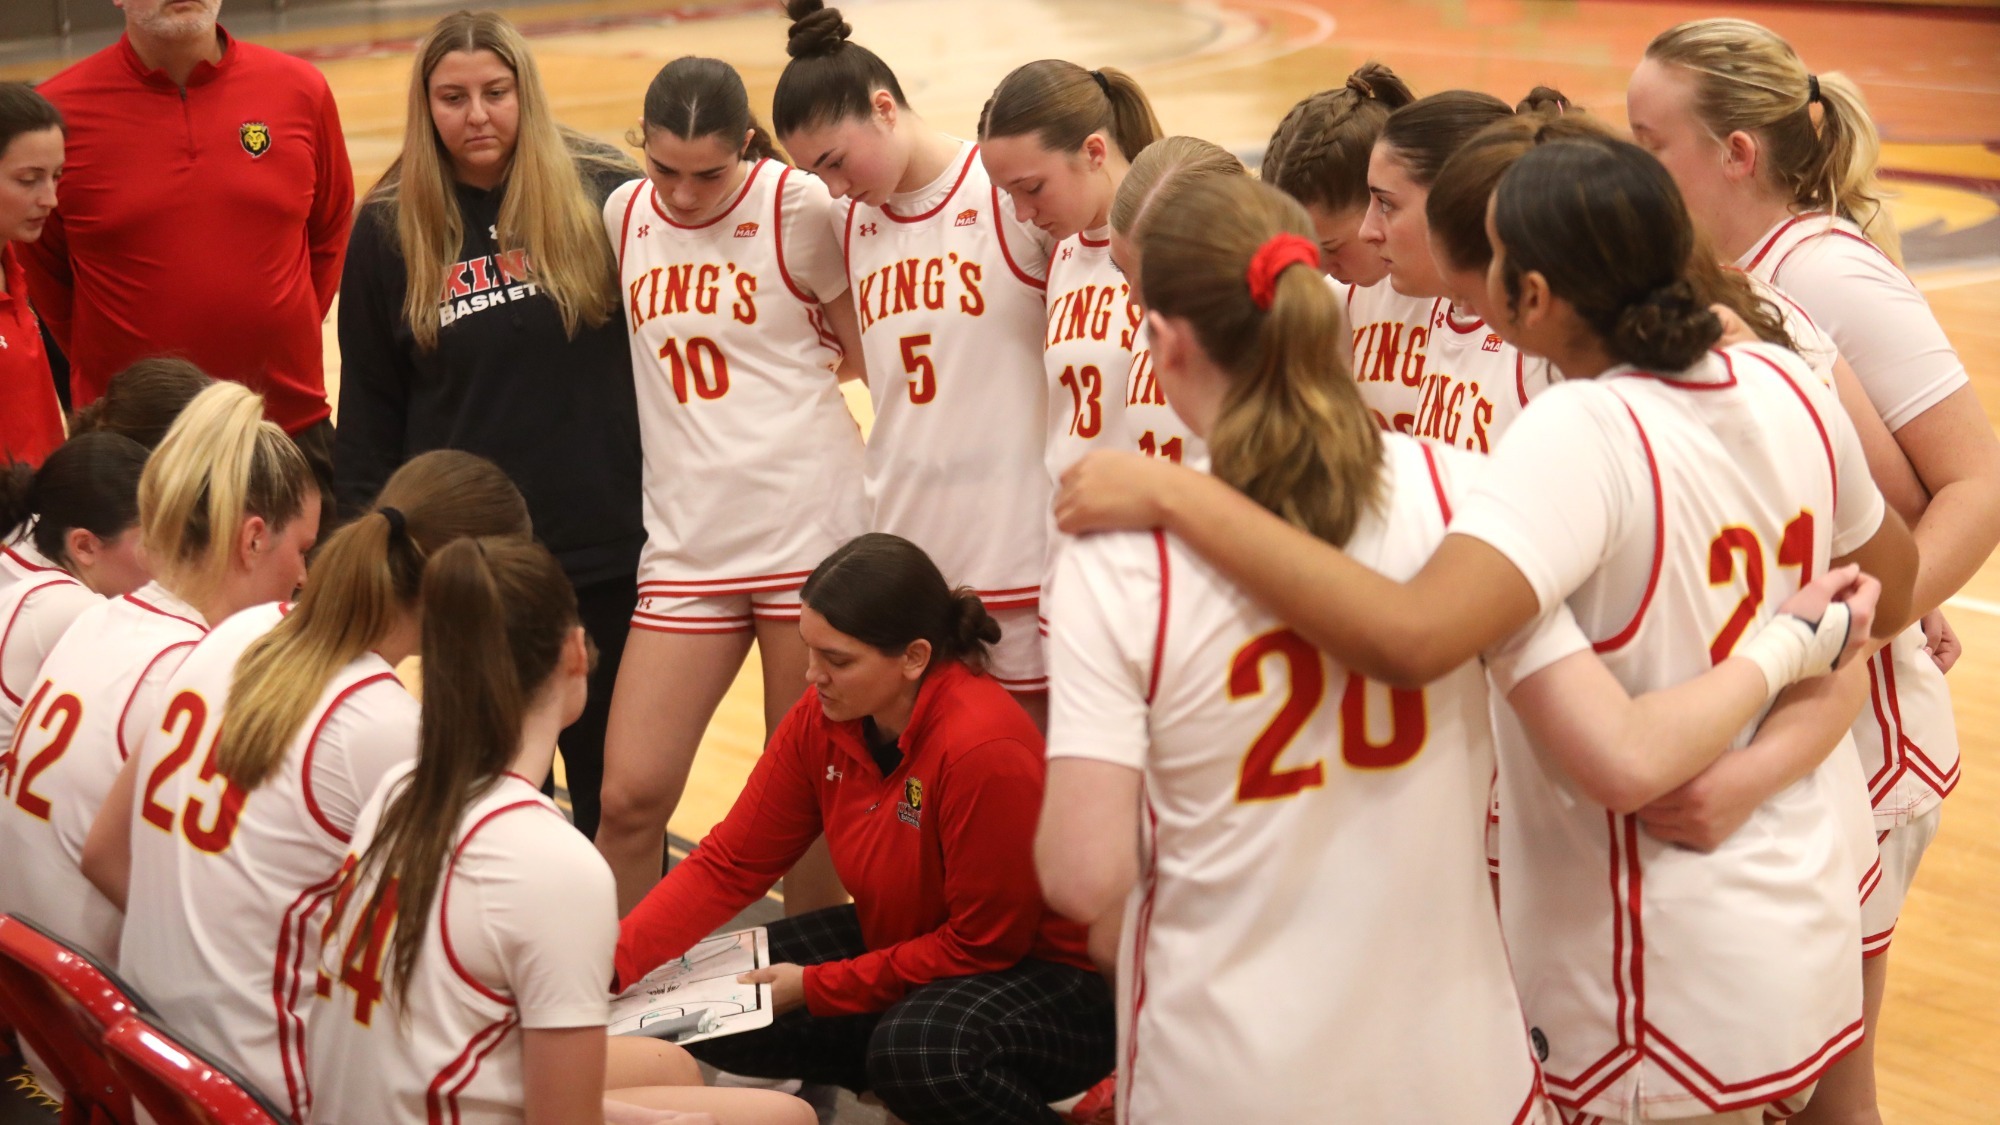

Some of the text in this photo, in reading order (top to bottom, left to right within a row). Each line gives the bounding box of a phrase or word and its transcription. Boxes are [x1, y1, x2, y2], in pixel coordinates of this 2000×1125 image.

[735, 229, 757, 238] MAC
[956, 216, 976, 226] MAC
[439, 283, 546, 328] BASKET
[440, 248, 537, 303] KIN
[628, 262, 759, 335] KING'S
[858, 252, 986, 336] KING'S
[658, 336, 731, 405] 10
[899, 332, 938, 405] 5
[1059, 364, 1102, 440] 13
[1413, 373, 1494, 456] ING'S
[1708, 507, 1815, 668] 21
[1226, 625, 1429, 804] 20
[140, 688, 252, 856] 25
